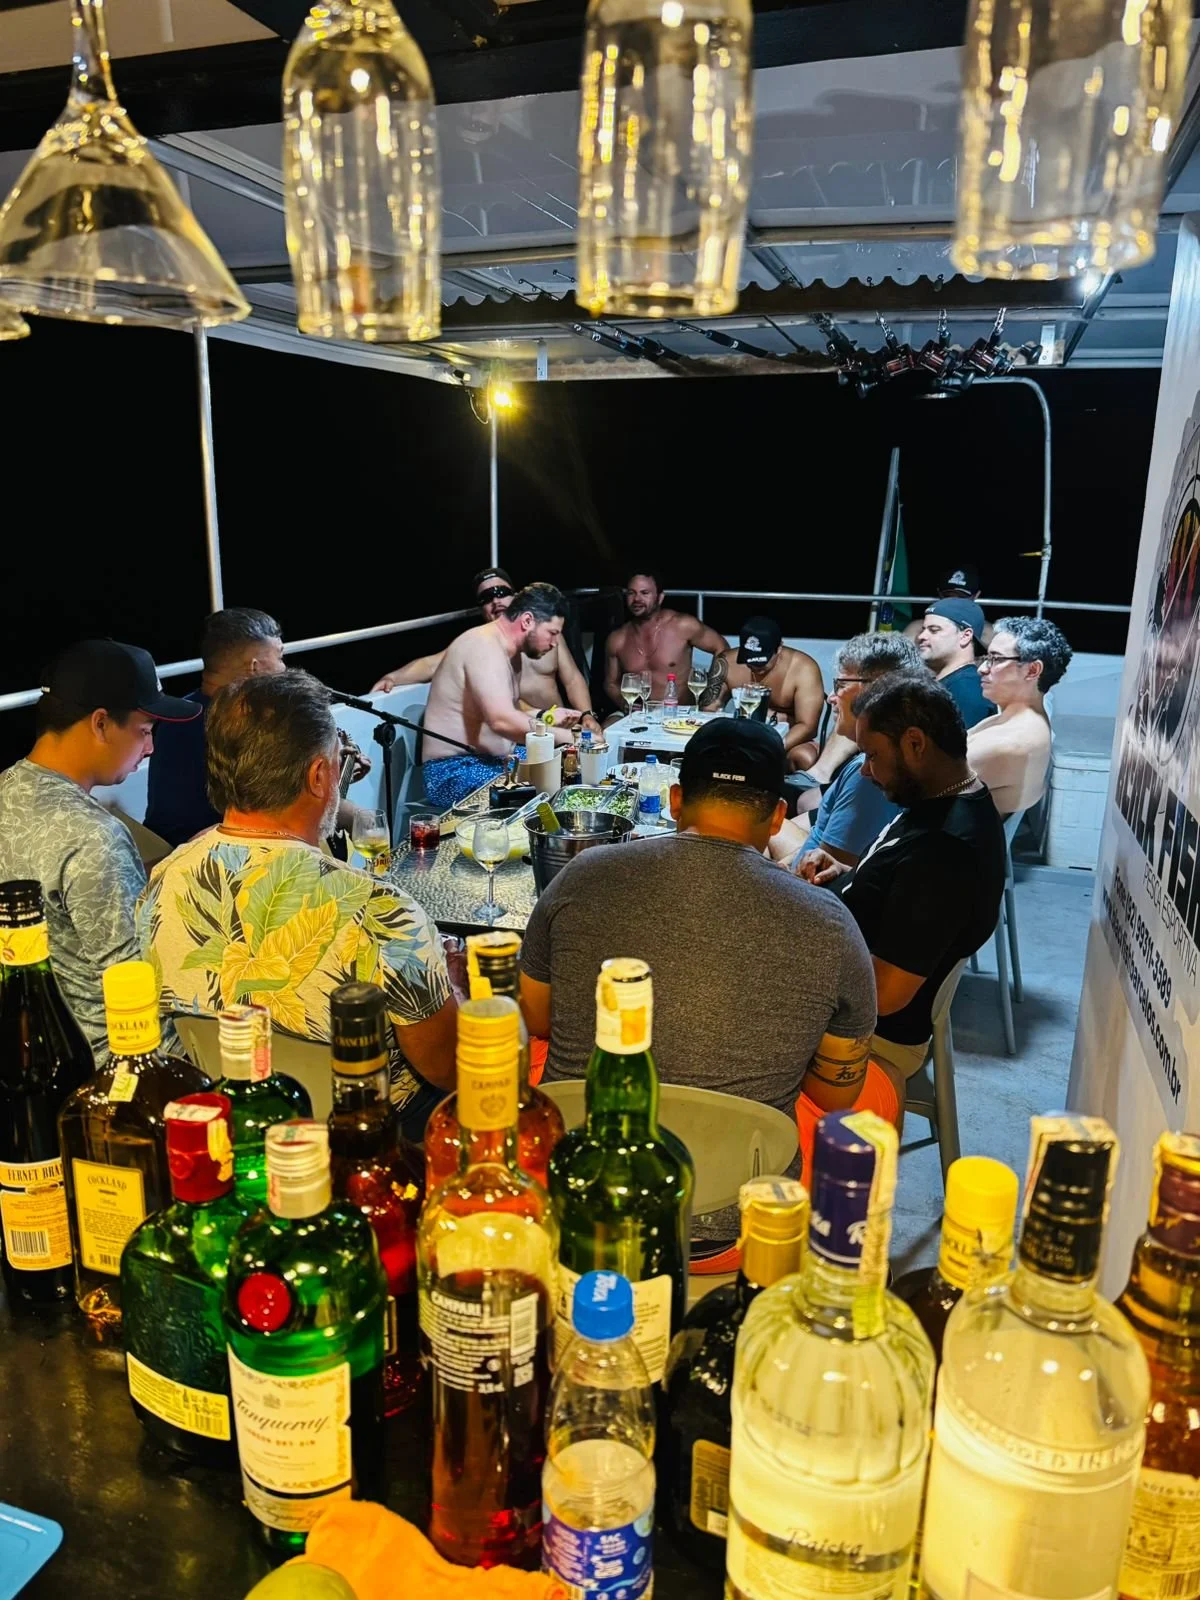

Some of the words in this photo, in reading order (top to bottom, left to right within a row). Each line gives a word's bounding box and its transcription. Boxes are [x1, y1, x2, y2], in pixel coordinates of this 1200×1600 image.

[713, 772, 731, 780] BLACK
[1143, 862, 1162, 914] PESCA
[1161, 894, 1198, 987] ESPORTIVA
[7, 1168, 38, 1182] FERNET
[431, 1290, 481, 1316] CAMPARI
[235, 1392, 329, 1433] Tanqueray
